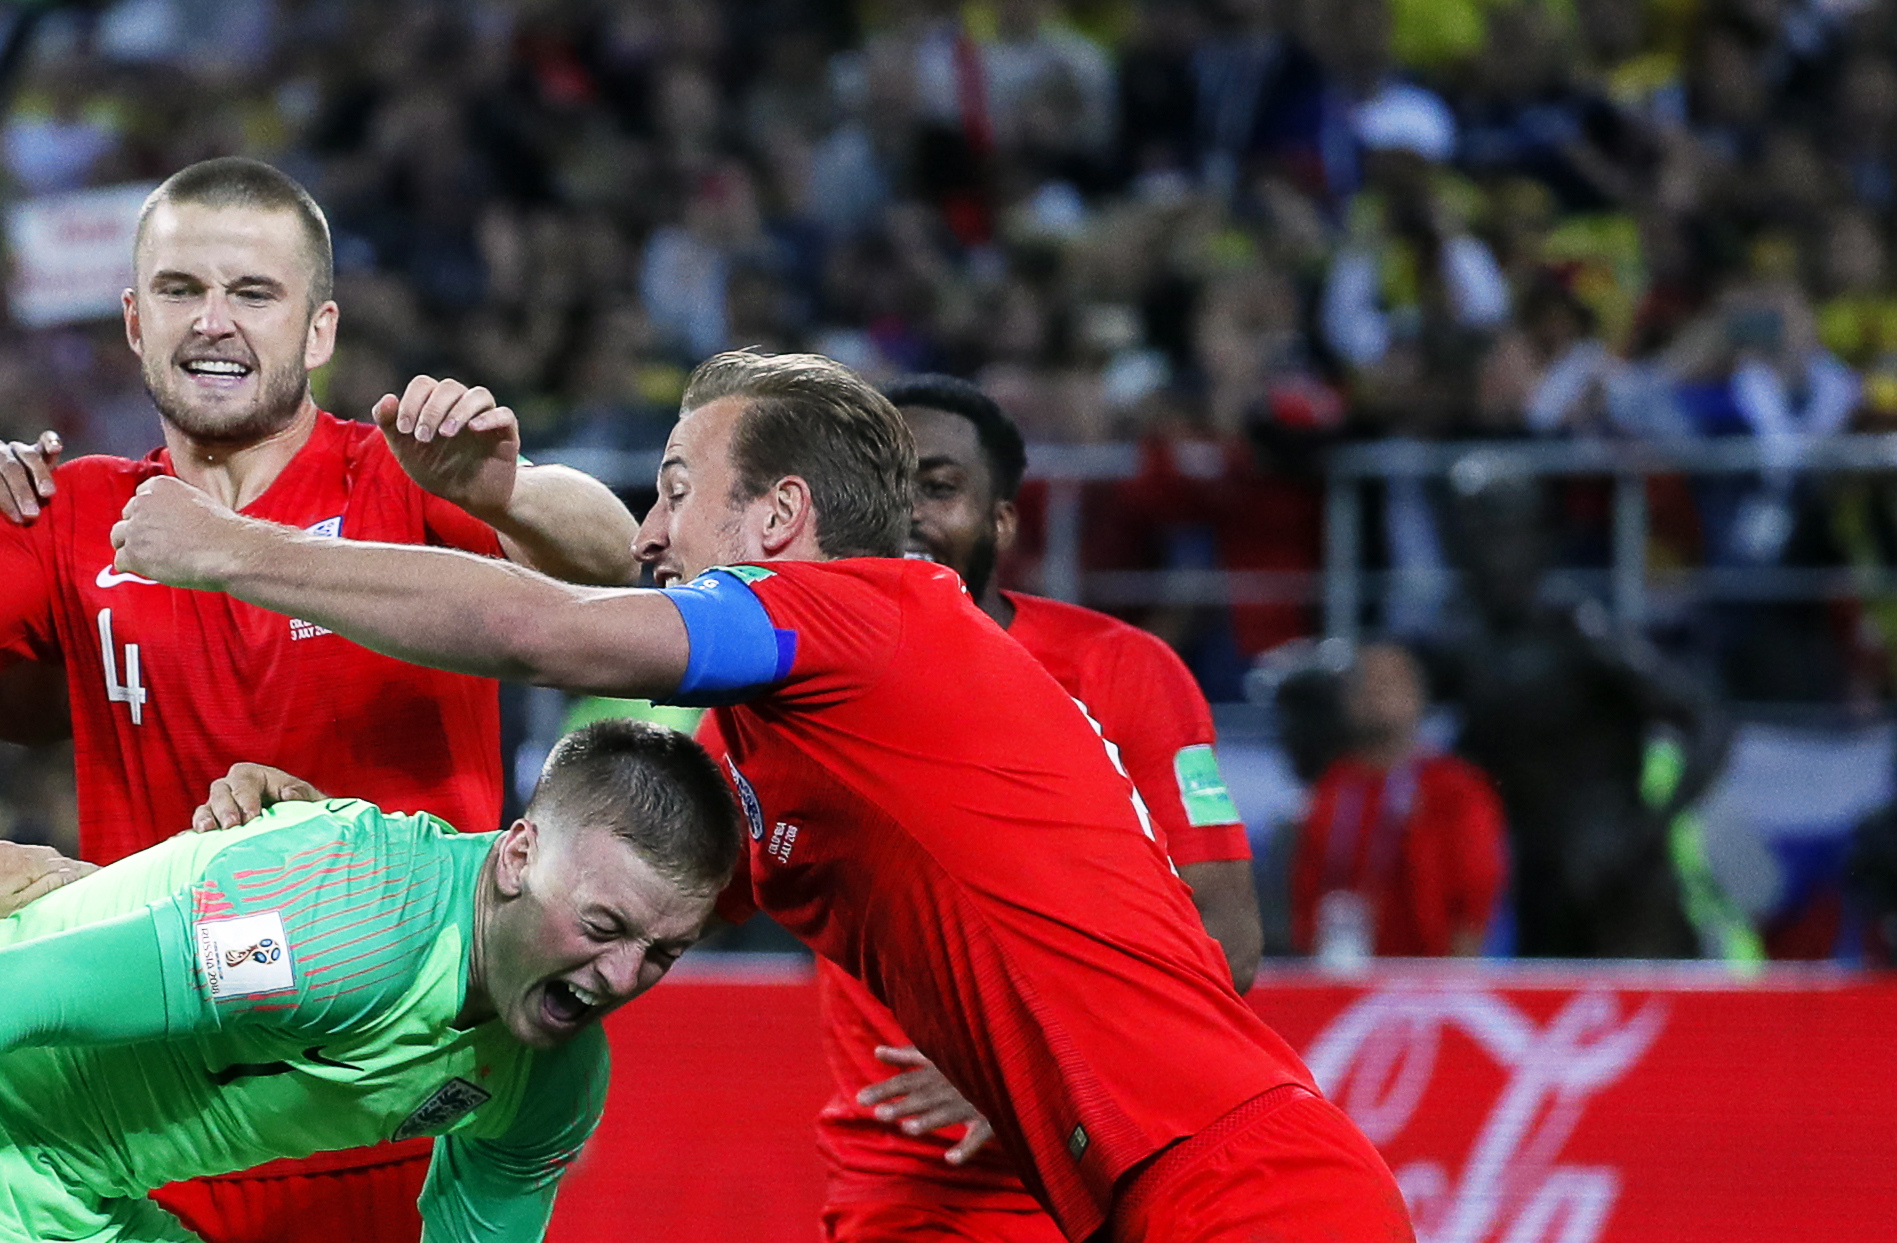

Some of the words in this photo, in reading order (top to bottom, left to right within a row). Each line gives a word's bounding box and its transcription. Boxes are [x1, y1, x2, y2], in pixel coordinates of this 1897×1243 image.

[97, 608, 146, 725] 4
[768, 822, 787, 855] COLOMBIA
[780, 840, 792, 858] JULY
[785, 825, 798, 842] 2018
[201, 928, 215, 970] RUSSIA
[209, 970, 220, 994] 2018
